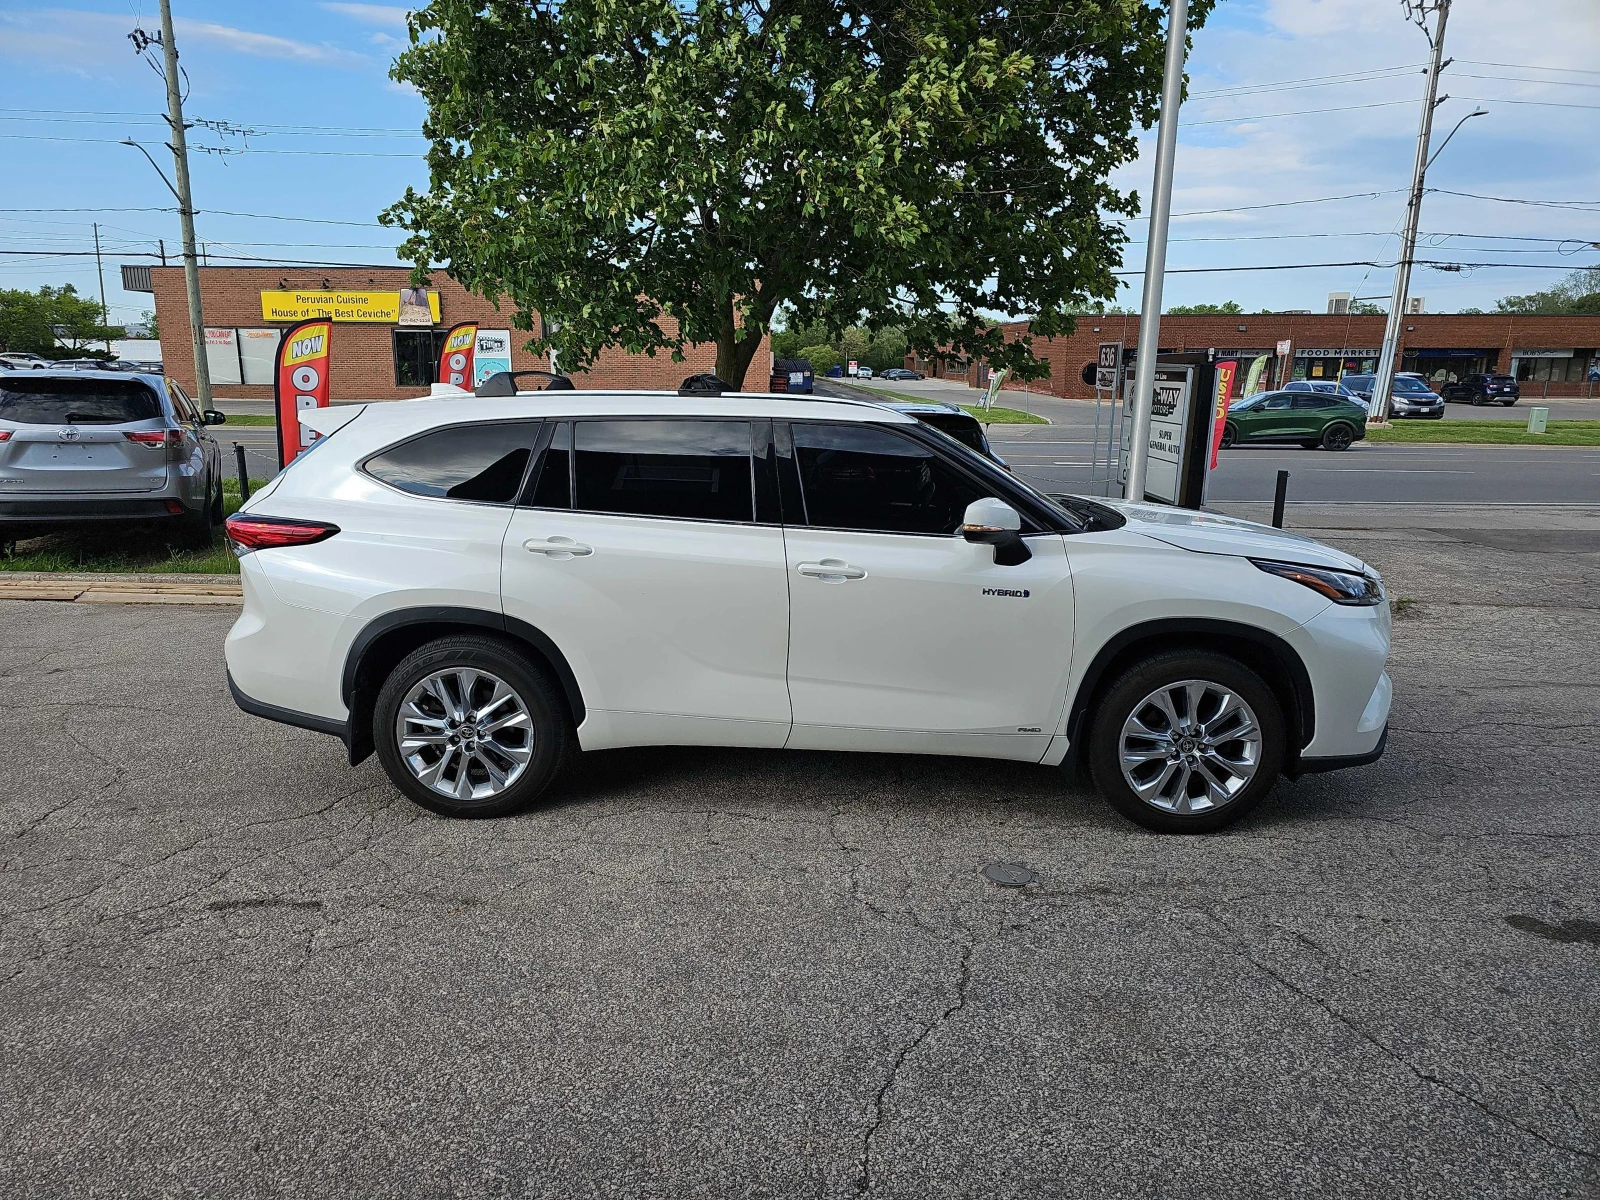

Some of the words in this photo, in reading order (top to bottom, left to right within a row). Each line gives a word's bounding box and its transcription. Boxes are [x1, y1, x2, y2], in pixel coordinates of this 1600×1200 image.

[296, 295, 333, 305] Peruvian
[336, 295, 369, 305] Cuisine
[271, 308, 298, 317] House
[301, 308, 310, 317] of
[335, 309, 356, 318] Best
[451, 333, 472, 348] NOW
[292, 335, 324, 359] NOW
[1101, 347, 1115, 366] 636
[1300, 349, 1330, 357] FOOD
[1334, 349, 1379, 357] MARKET
[1216, 368, 1231, 419] USED
[1159, 430, 1172, 441] SUPER
[1150, 440, 1167, 452] GENERAL
[982, 588, 1022, 597] HYBRID
